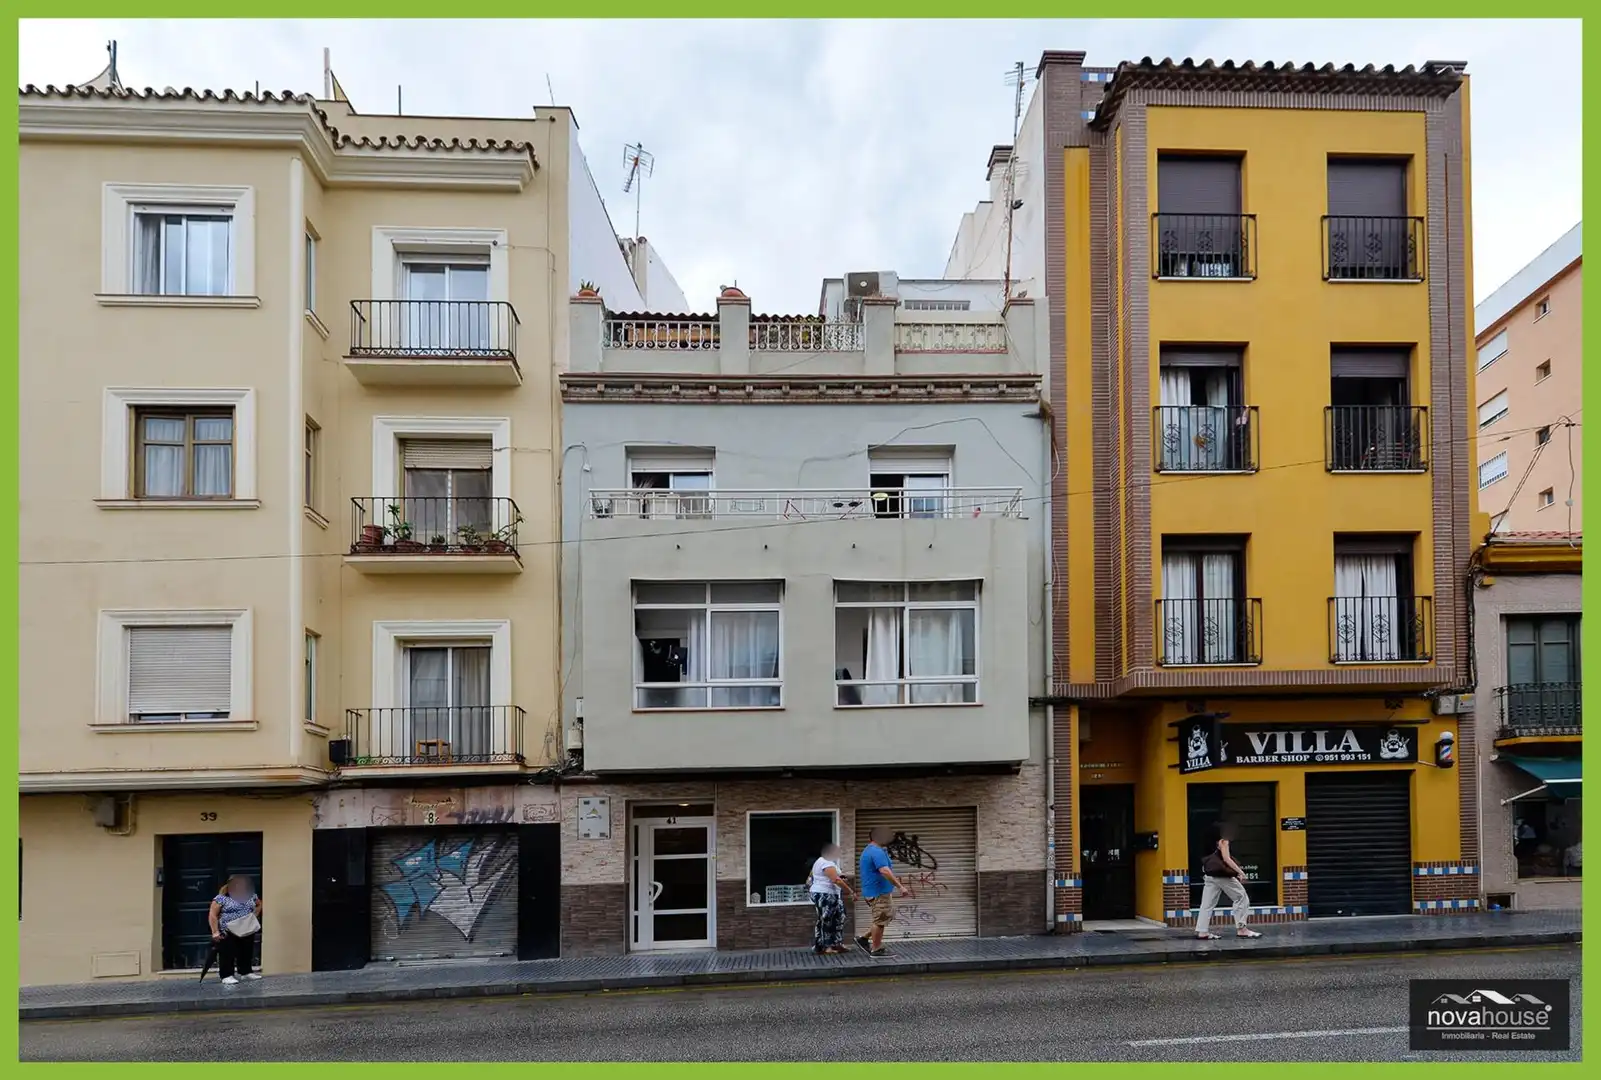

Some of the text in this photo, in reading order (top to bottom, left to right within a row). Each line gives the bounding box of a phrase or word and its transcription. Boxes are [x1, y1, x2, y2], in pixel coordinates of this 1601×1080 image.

[1245, 729, 1364, 755] VILLA
[1186, 755, 1211, 768] VILLA
[1236, 752, 1371, 764] BARBER SHOP 951 993 151
[200, 811, 217, 822] 39
[666, 816, 677, 825] 41
